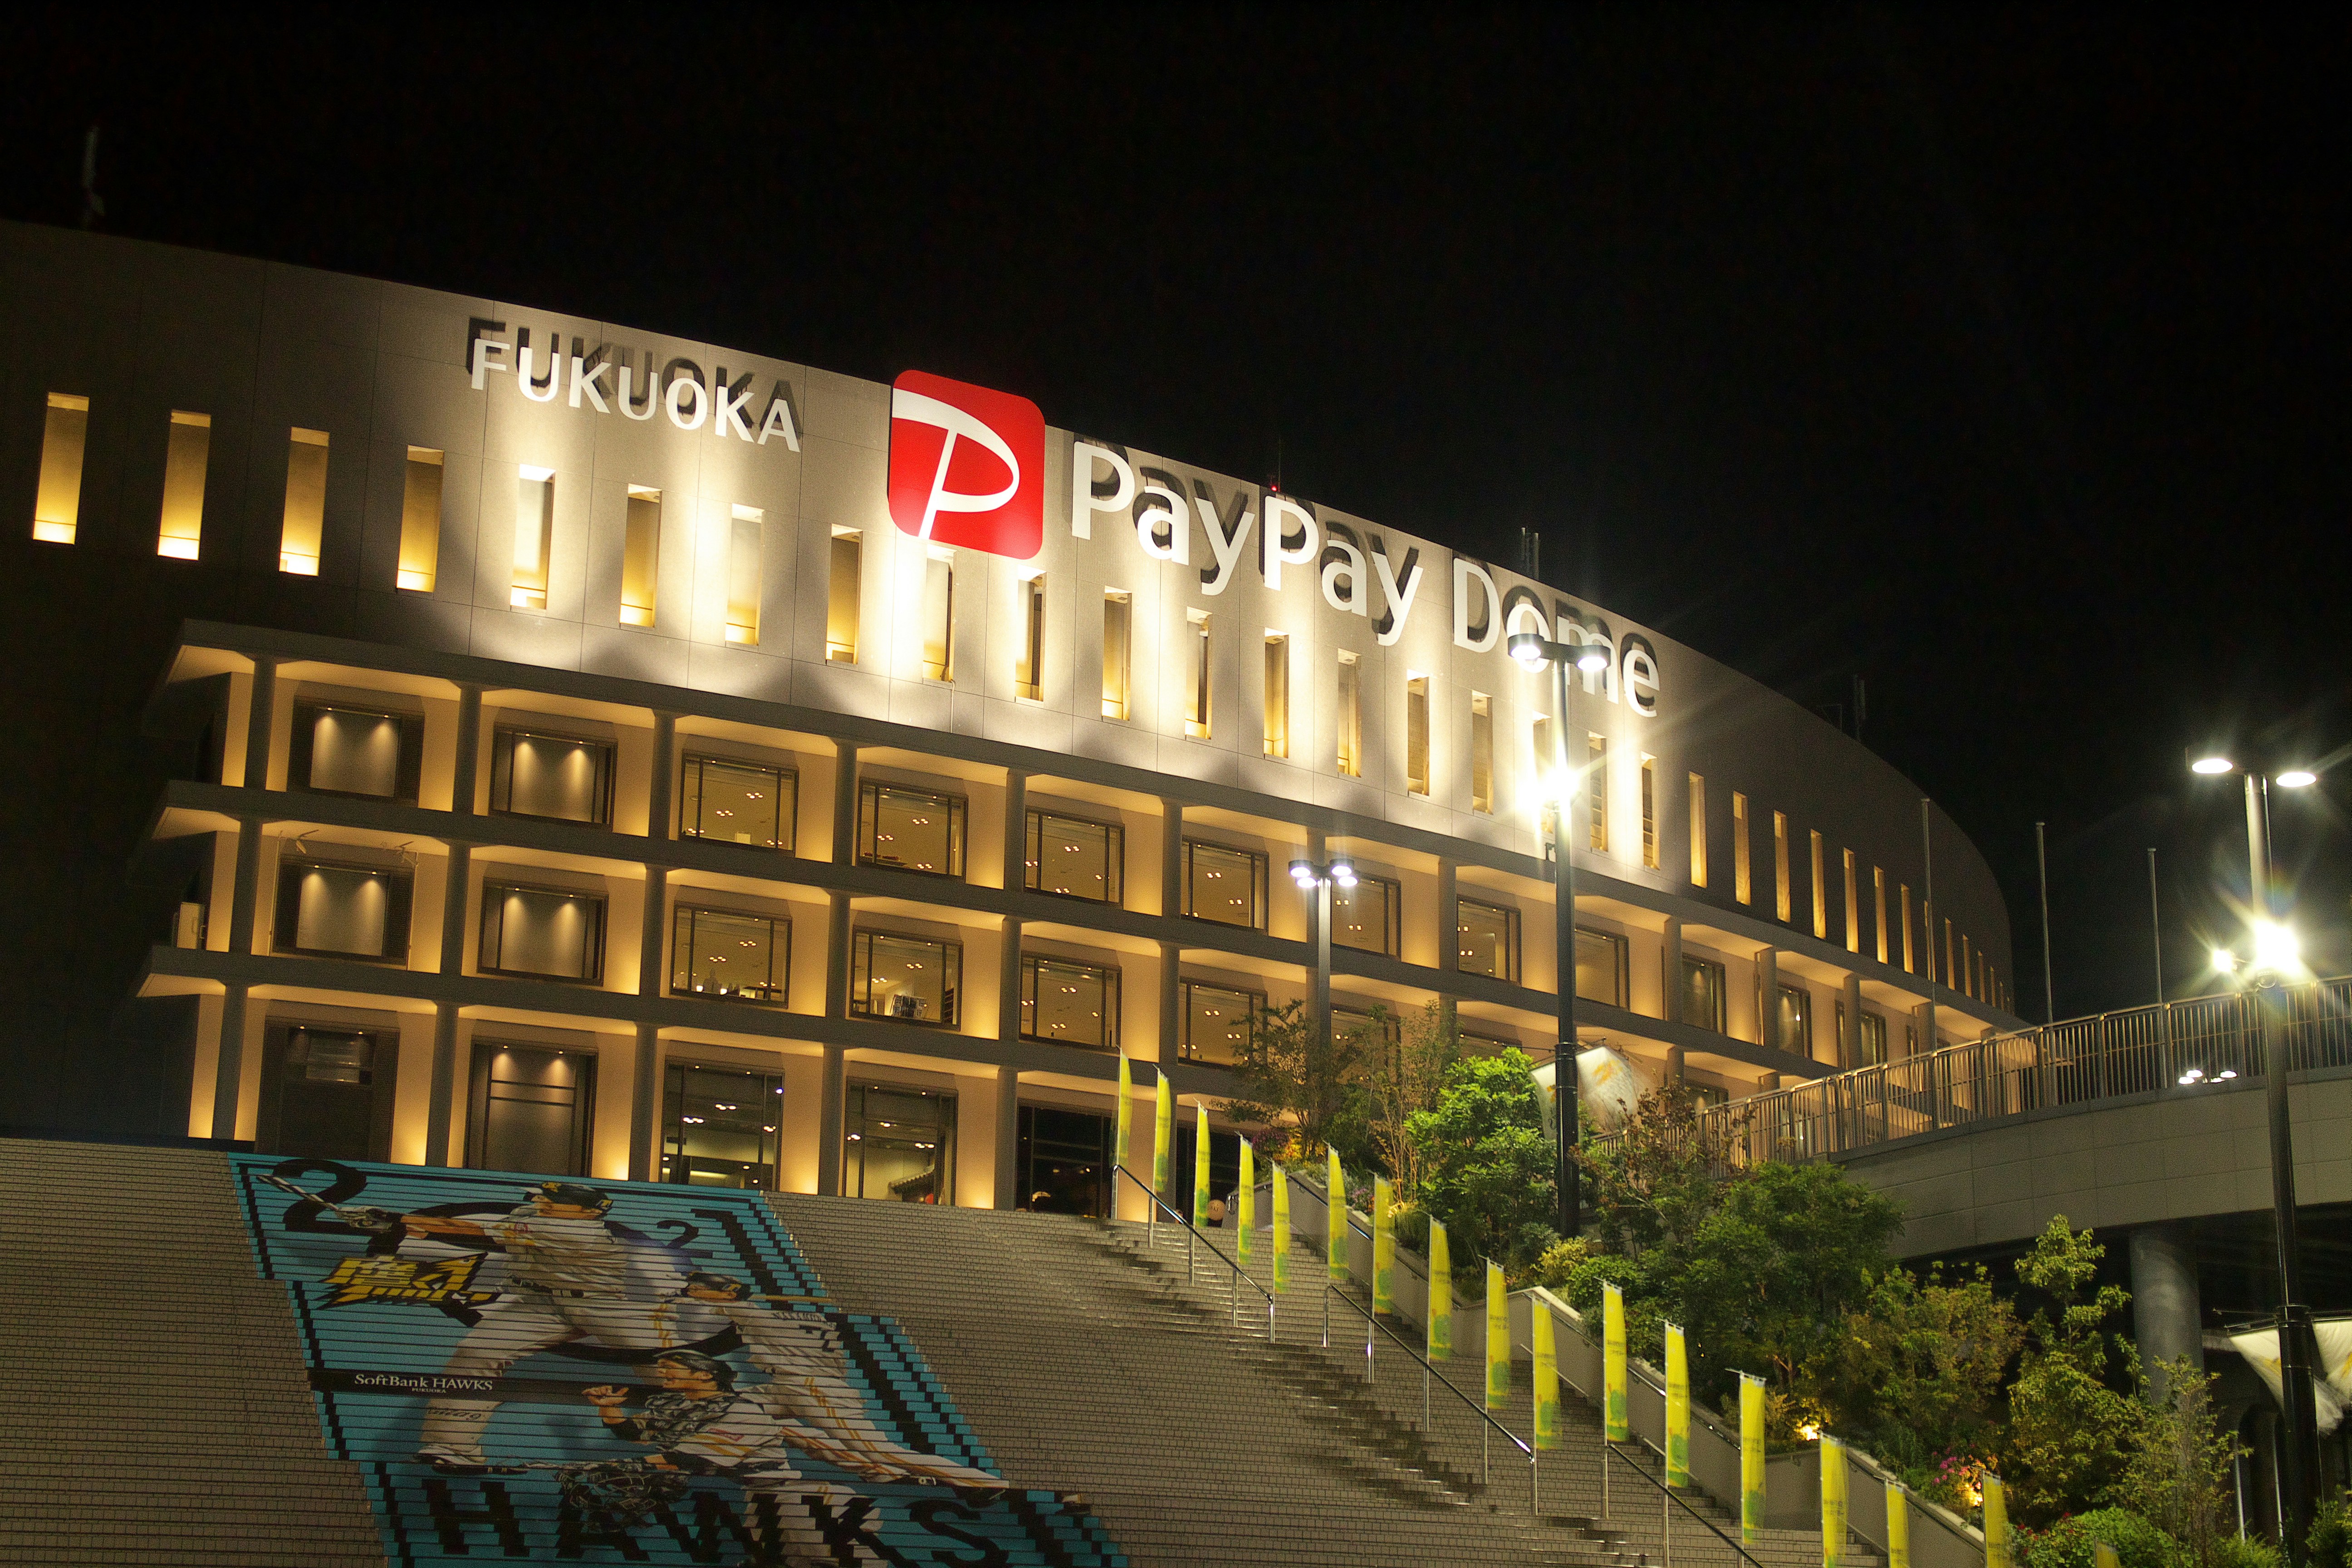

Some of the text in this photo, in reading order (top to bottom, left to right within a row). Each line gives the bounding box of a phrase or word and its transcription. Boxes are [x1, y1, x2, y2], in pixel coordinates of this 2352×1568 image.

[471, 338, 800, 452] FUKUOKA
[1072, 441, 1660, 717] PayPay Dome
[354, 1373, 493, 1392] SoftBank HAWKS
